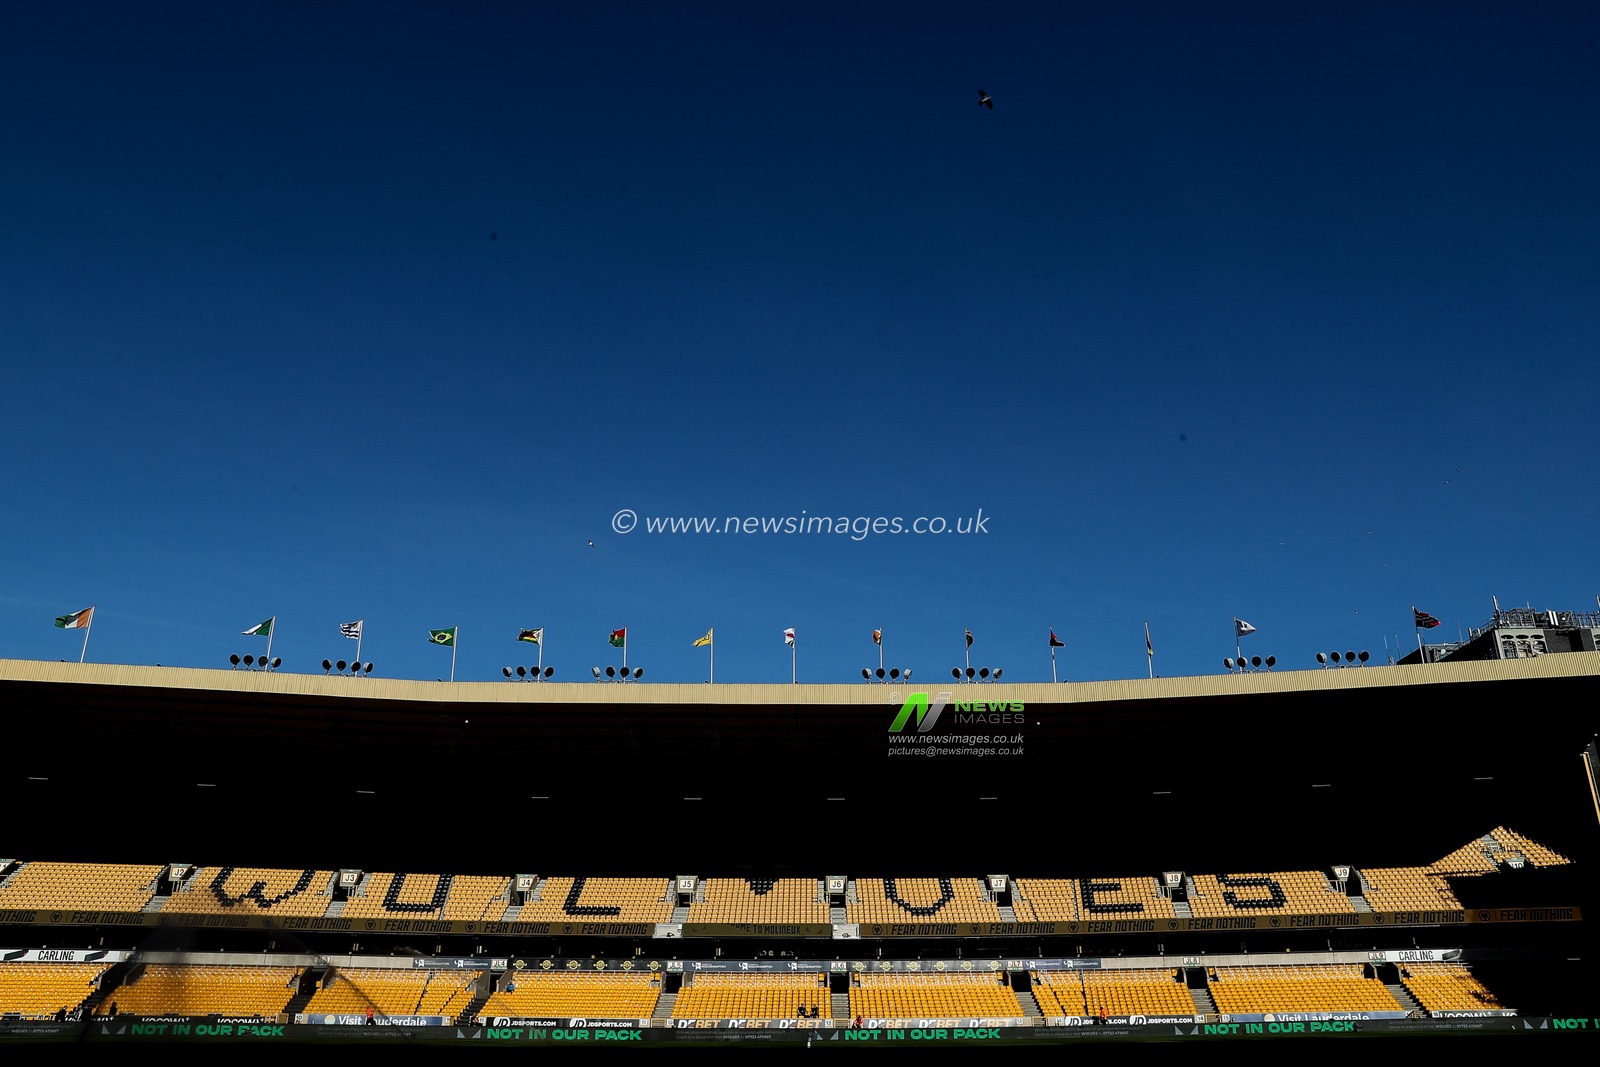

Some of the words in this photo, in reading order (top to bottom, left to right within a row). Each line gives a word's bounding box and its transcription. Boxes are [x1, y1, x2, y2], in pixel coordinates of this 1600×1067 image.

[174, 868, 185, 877] J2
[345, 874, 354, 882] J3
[1170, 874, 1179, 882] J8
[1338, 869, 1347, 878] J9
[521, 879, 531, 887] J4
[682, 880, 692, 888] J5
[832, 880, 842, 888] J6
[994, 880, 1003, 888] J7
[70, 913, 98, 924] FEAR
[100, 913, 144, 925] NOTHING
[1394, 913, 1420, 924] FEAR
[1423, 911, 1465, 923] NOTHING
[1501, 910, 1526, 921] FEAR
[1529, 908, 1573, 920] NOTHING
[282, 917, 307, 928] FEAR
[309, 917, 352, 929] NOTHING
[385, 920, 409, 931] FEAR
[411, 920, 453, 932] NOTHING
[1188, 921, 1213, 931] FEAR
[1215, 919, 1256, 930] NOTHING
[1291, 918, 1316, 927] FEAR
[1317, 916, 1359, 926] NOTHING
[484, 922, 508, 932] FEAR
[510, 922, 550, 934] NOTHING
[581, 924, 606, 935] FEAR
[607, 924, 648, 935] NOTHING
[891, 924, 917, 935] FEAR
[918, 924, 957, 935] NOTHING
[989, 924, 1013, 934] FEAR
[1015, 924, 1055, 934] NOTHING
[1088, 923, 1112, 933] FEAR
[1114, 922, 1154, 932] NOTHING
[38, 951, 74, 960] CARLING
[1399, 951, 1434, 960] CARLING
[338, 1015, 362, 1025] Visit
[365, 1016, 427, 1026] auderdale
[1277, 1013, 1302, 1021] Visit
[1204, 1024, 1240, 1034] NOT
[1245, 1023, 1263, 1034] IN
[1268, 1023, 1305, 1033] OUR
[1310, 1022, 1354, 1032] PACK
[1553, 1018, 1588, 1029] NOT
[131, 1024, 164, 1035] NOT
[173, 1025, 191, 1035] IN
[195, 1025, 232, 1035] OUR
[237, 1025, 285, 1036] PACK
[486, 1028, 523, 1039] NOT
[528, 1029, 547, 1039] IN
[551, 1029, 589, 1040] OUR
[595, 1030, 642, 1040] PACK
[845, 1030, 881, 1040] NOT
[887, 1030, 905, 1040] IN
[910, 1029, 948, 1039] OUR
[953, 1029, 1001, 1039] PACK
